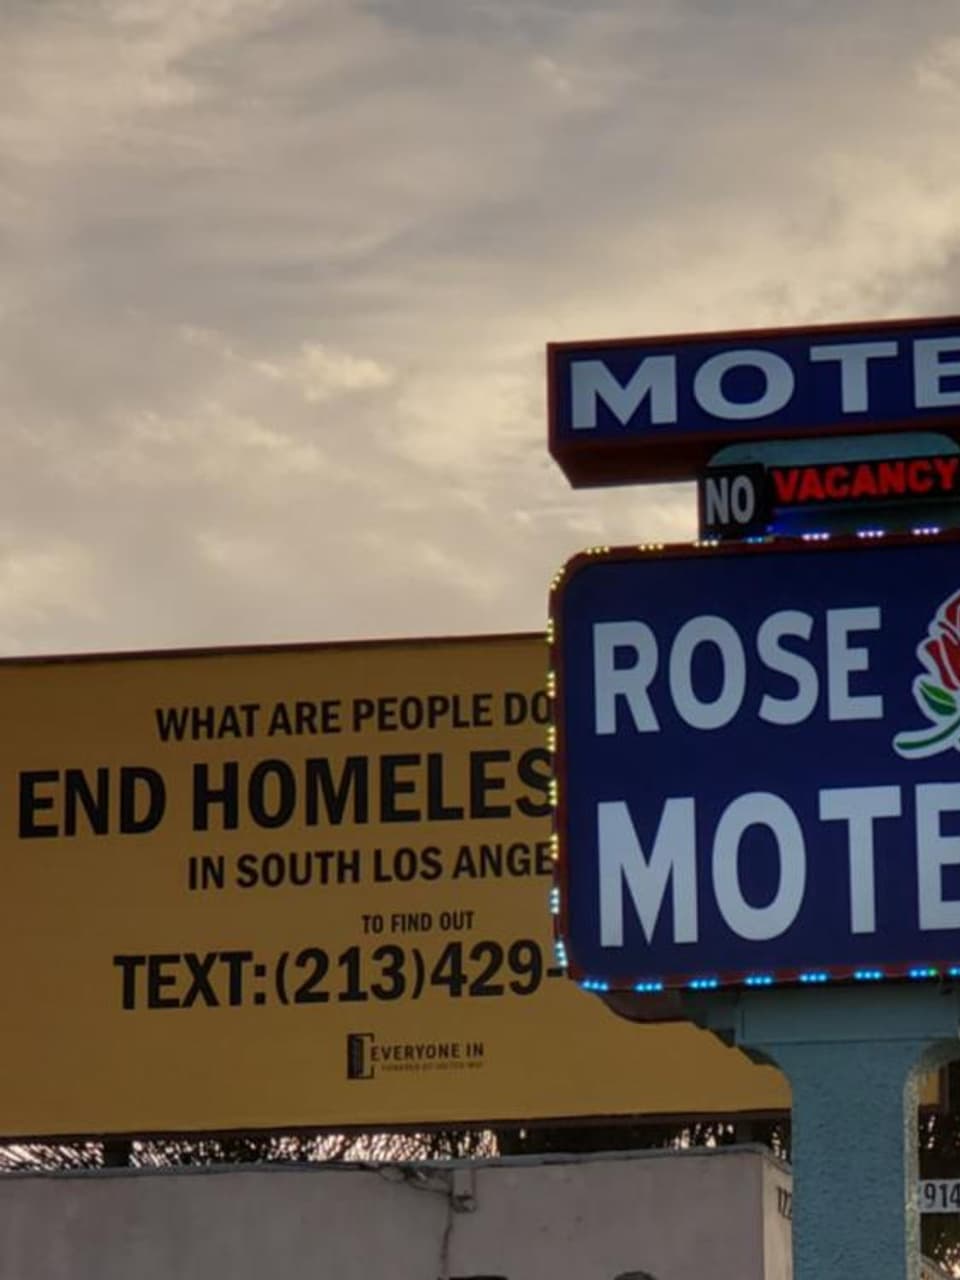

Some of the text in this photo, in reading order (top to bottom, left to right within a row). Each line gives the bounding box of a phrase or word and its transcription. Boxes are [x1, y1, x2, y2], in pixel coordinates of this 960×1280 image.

[705, 475, 756, 525] NO
[593, 606, 884, 734] ROSE
[155, 704, 260, 742] WHAT
[268, 700, 341, 736] ARE
[352, 694, 492, 732] PEOPLE
[18, 747, 556, 840] END HOMELES
[188, 856, 224, 891] IN
[236, 849, 360, 889] SOUTH
[373, 847, 442, 883] LOS
[362, 911, 475, 933] TO FIND OUT
[371, 1042, 484, 1061] EVERYONE IN
